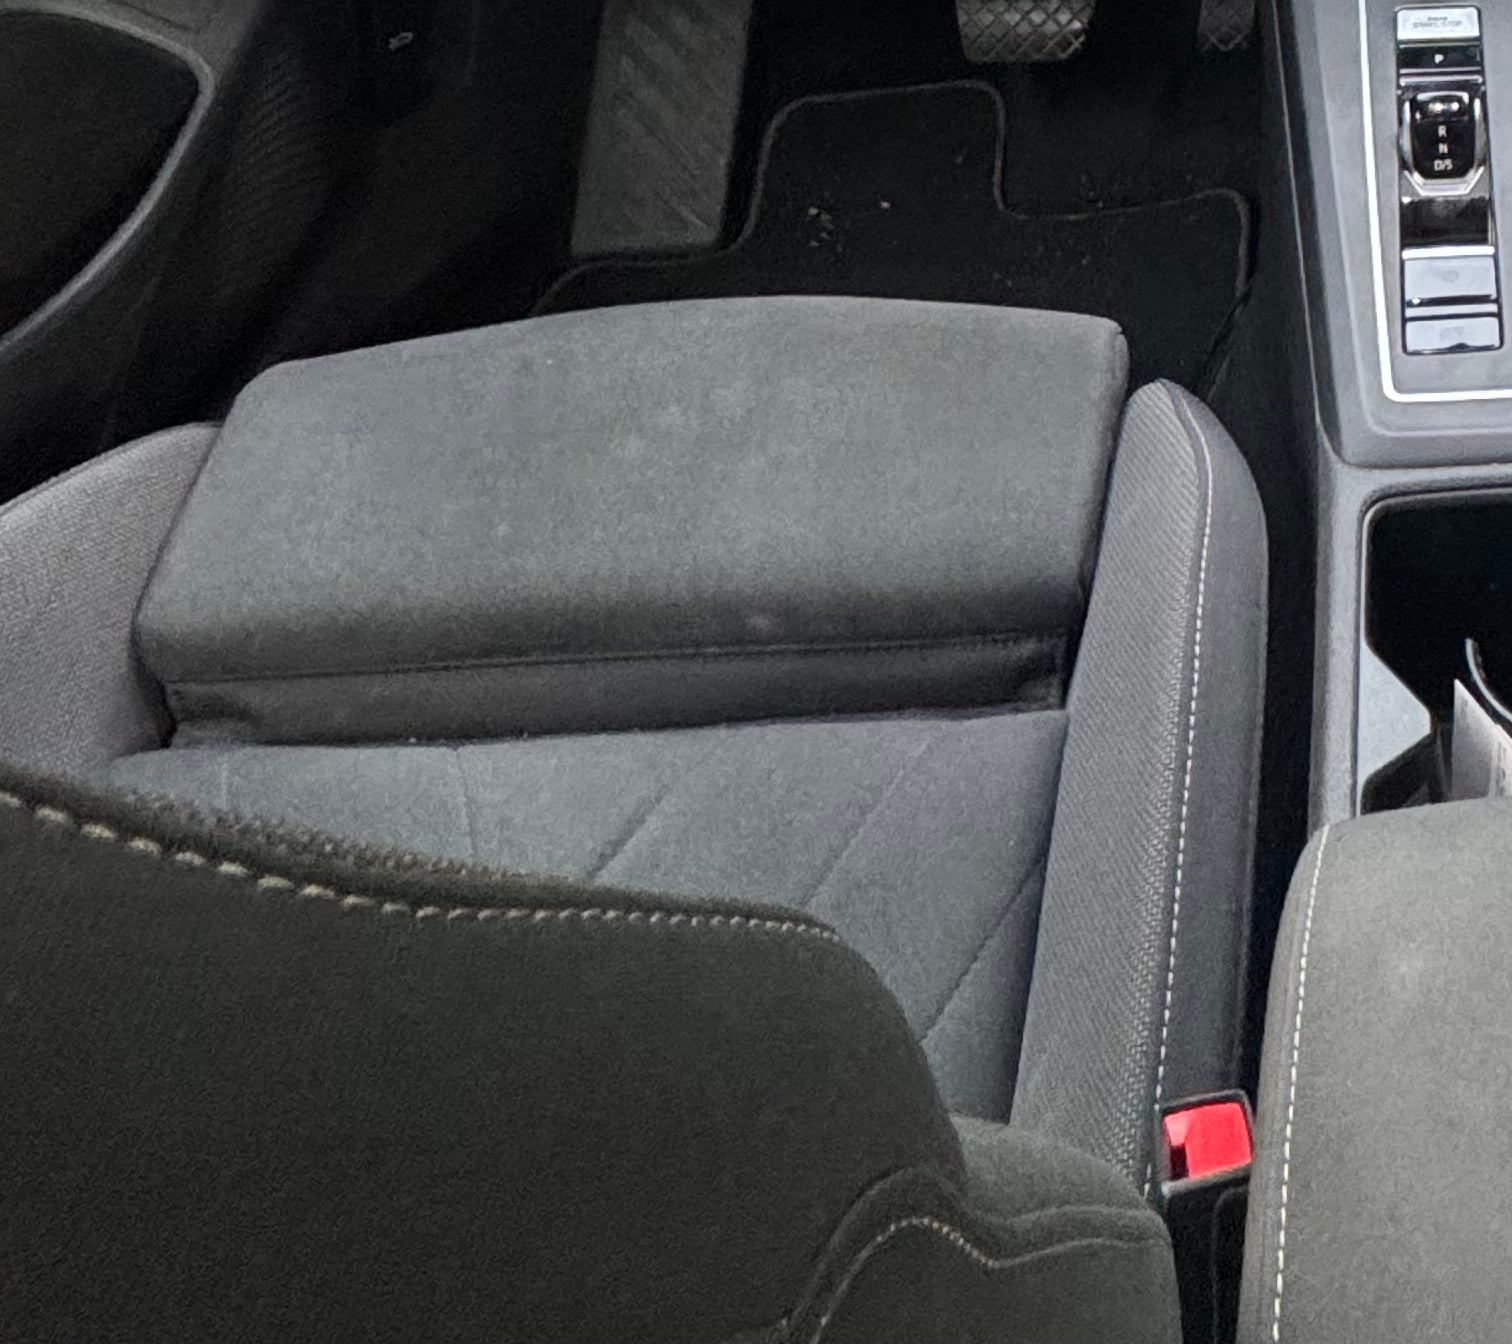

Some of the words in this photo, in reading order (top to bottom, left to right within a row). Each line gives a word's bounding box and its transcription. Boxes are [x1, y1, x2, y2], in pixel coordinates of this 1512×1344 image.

[1434, 54, 1445, 65] P
[1438, 125, 1448, 138] R
[1438, 143, 1449, 154] N
[1433, 158, 1454, 171] D/S
